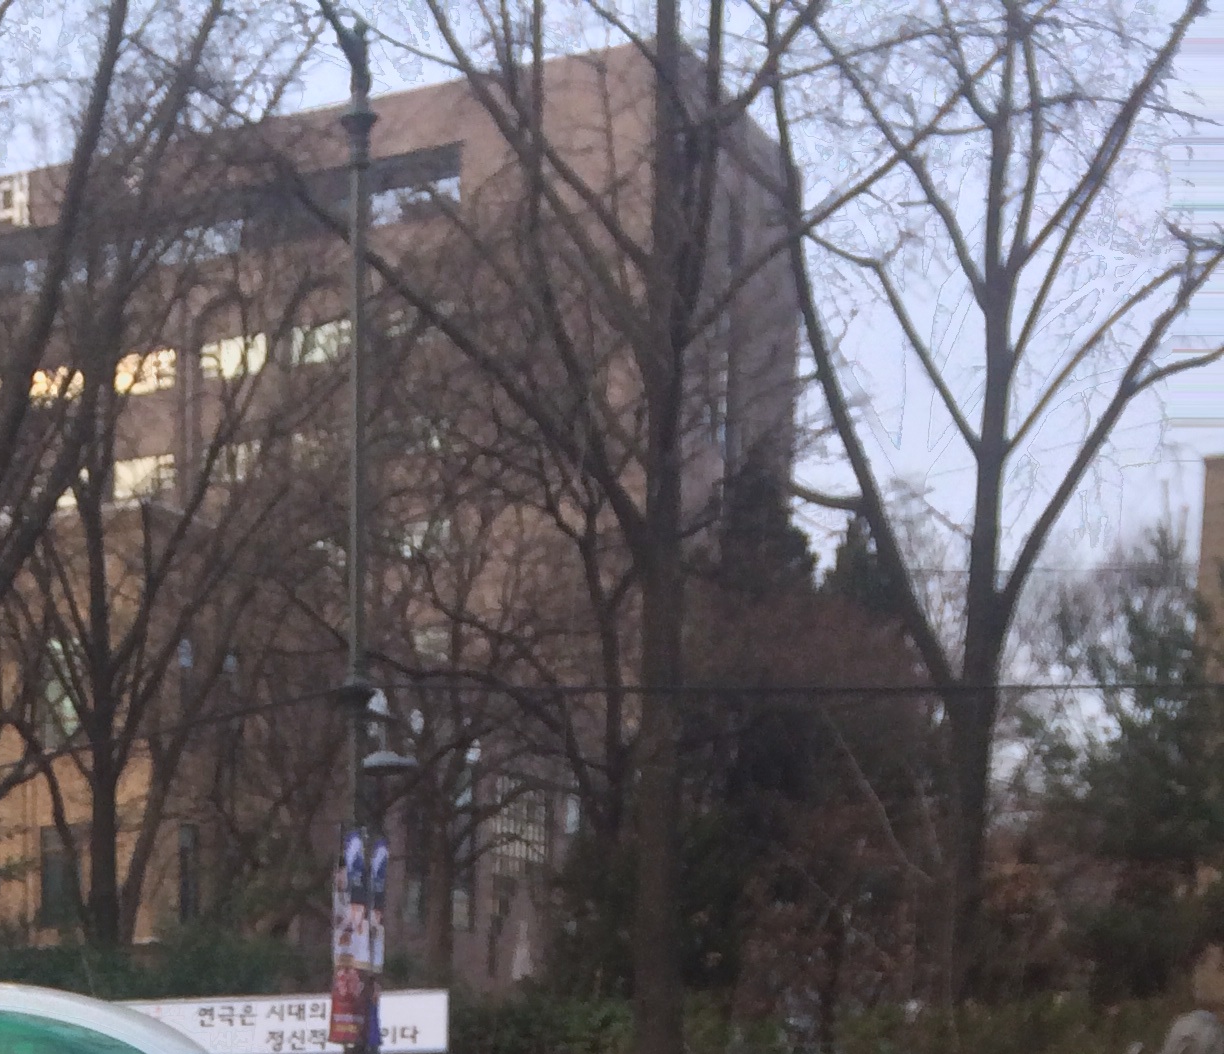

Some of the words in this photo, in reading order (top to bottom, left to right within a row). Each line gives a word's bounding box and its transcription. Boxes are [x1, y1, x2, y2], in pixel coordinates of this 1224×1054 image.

[198, 1004, 256, 1028] 연극은
[266, 1002, 326, 1021] 시대의
[266, 1029, 326, 1052] 정신적
